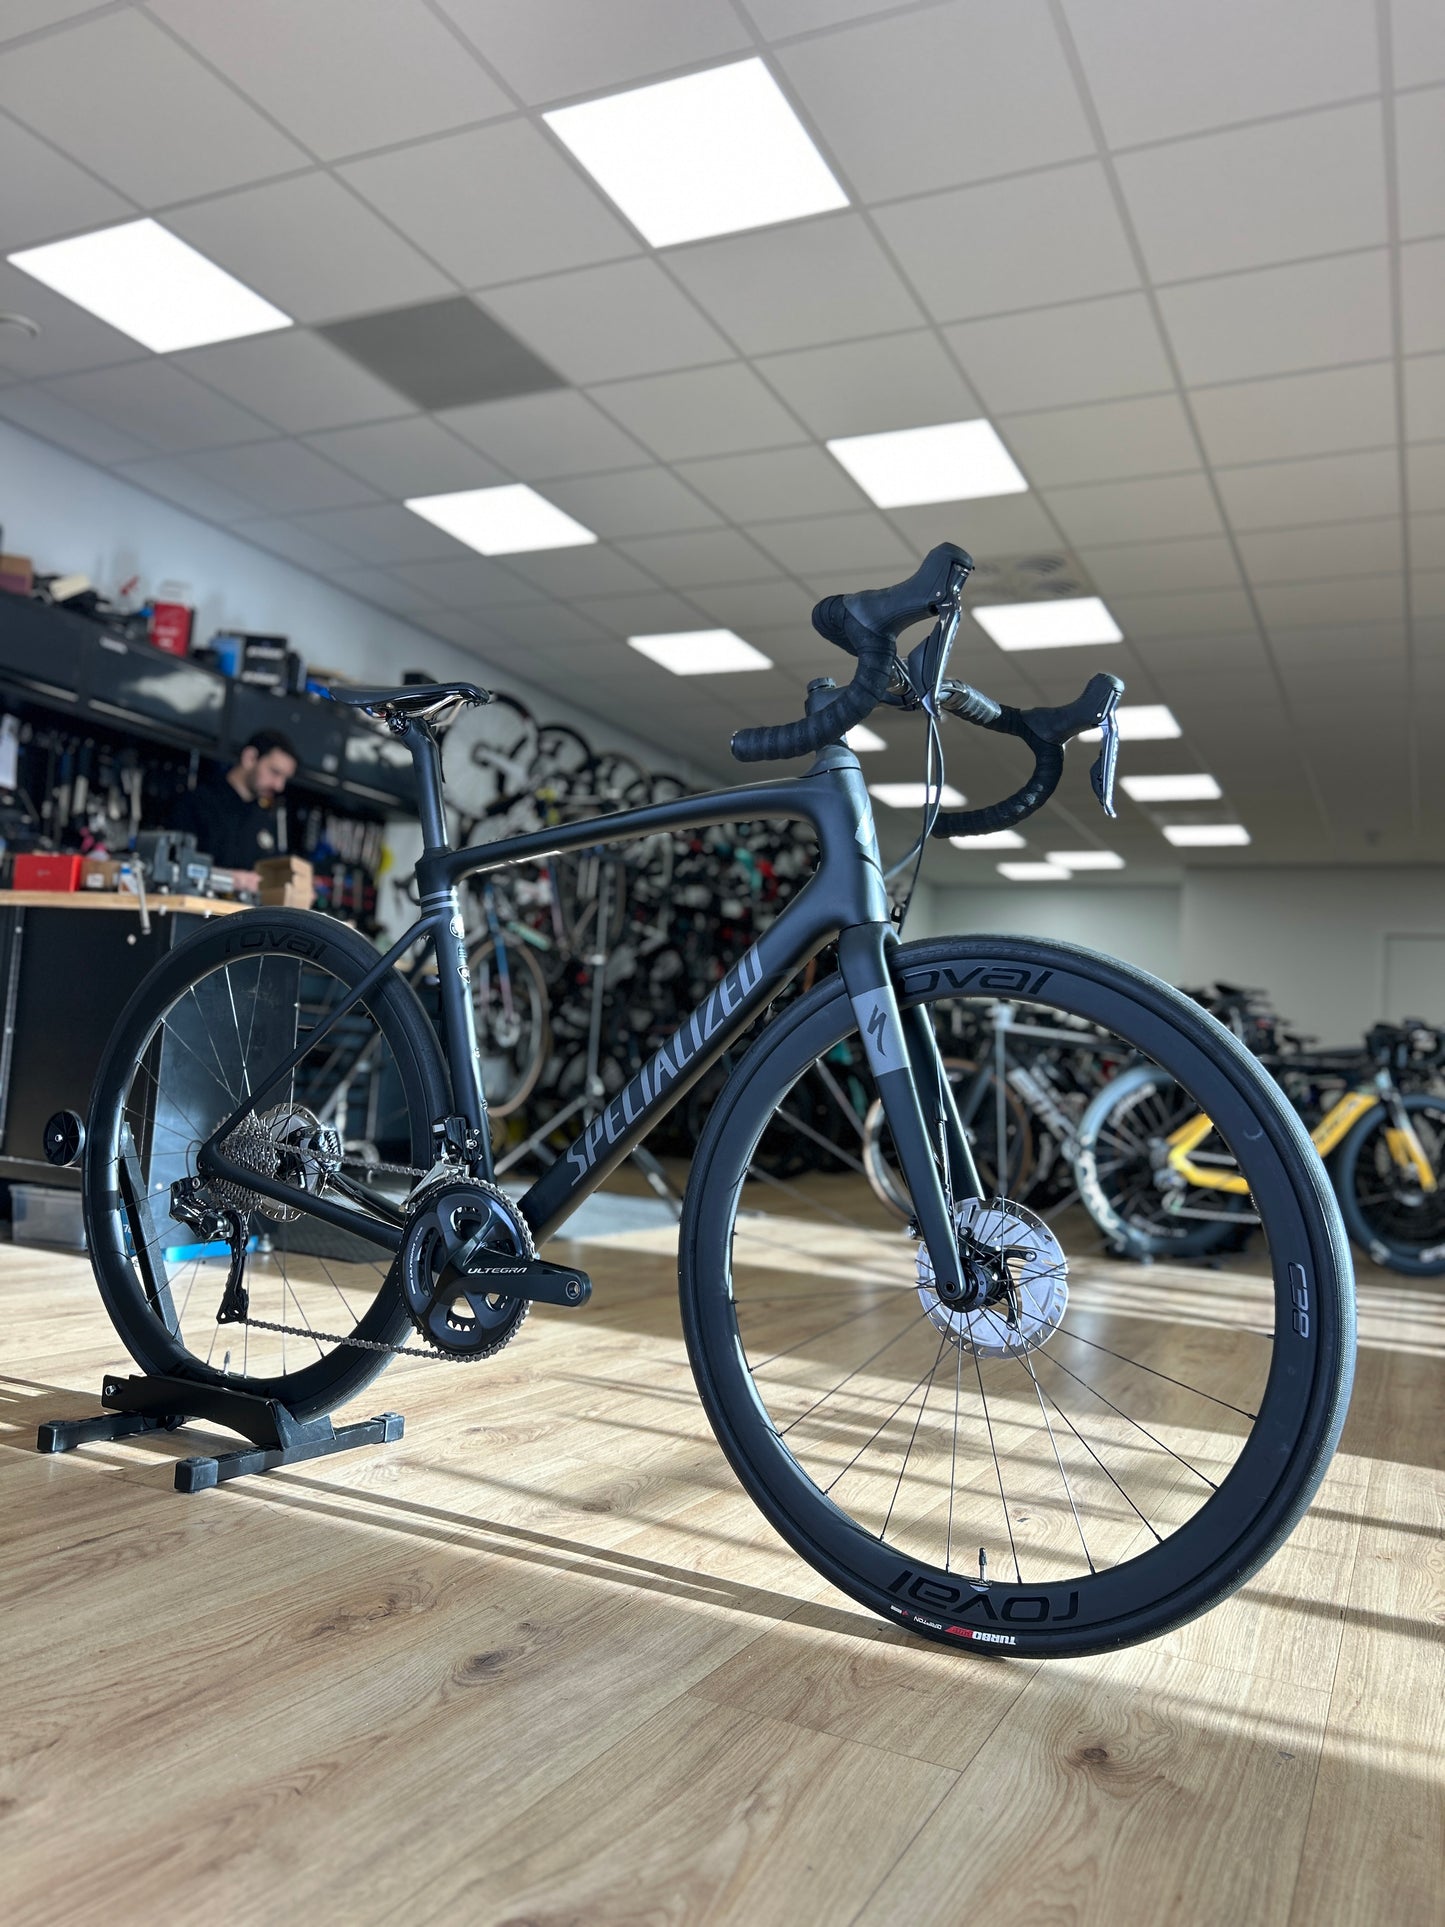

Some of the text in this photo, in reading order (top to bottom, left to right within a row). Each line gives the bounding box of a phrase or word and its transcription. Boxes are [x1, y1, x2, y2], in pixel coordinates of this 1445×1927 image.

[225, 930, 328, 960] roval
[900, 965, 1054, 995] oval
[566, 942, 763, 1187] SPECIALIZED
[1287, 1261, 1310, 1339] C38
[887, 1569, 1080, 1624] roval
[971, 1630, 1017, 1646] TURBO
